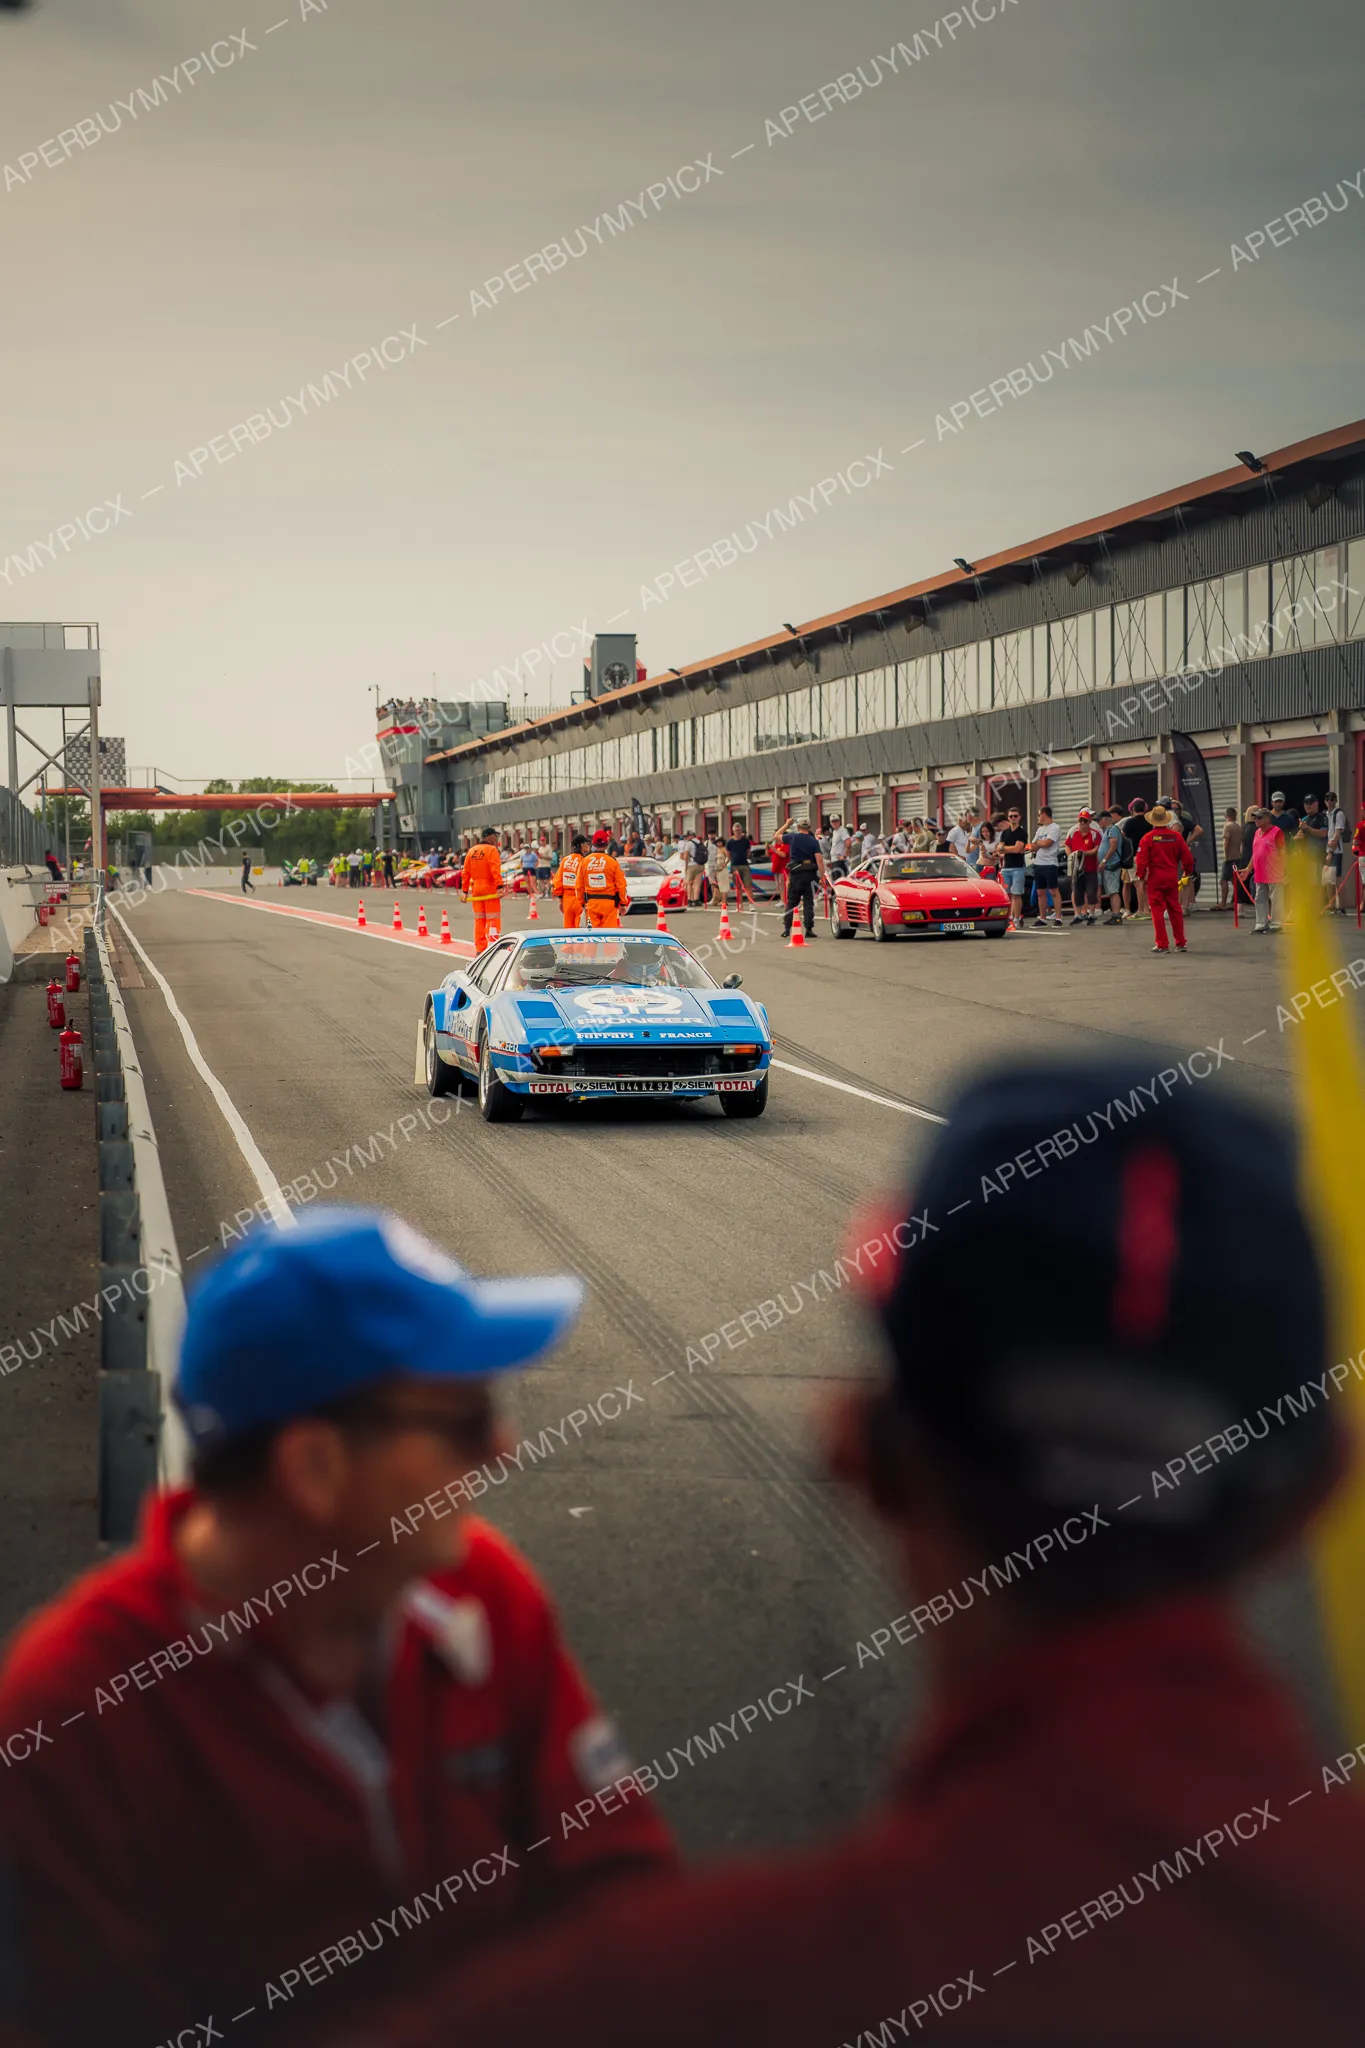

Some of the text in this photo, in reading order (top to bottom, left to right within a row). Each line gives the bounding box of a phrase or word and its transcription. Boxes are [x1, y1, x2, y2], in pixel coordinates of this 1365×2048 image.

[548, 936, 653, 944] PIONEER
[577, 1017, 704, 1025] PIONEER
[530, 1083, 572, 1093] TOTAL
[588, 1081, 615, 1090] SIEM
[619, 1083, 669, 1091] 844 KZ 92
[687, 1081, 714, 1090] SIEM
[715, 1080, 756, 1091] TOTAL
